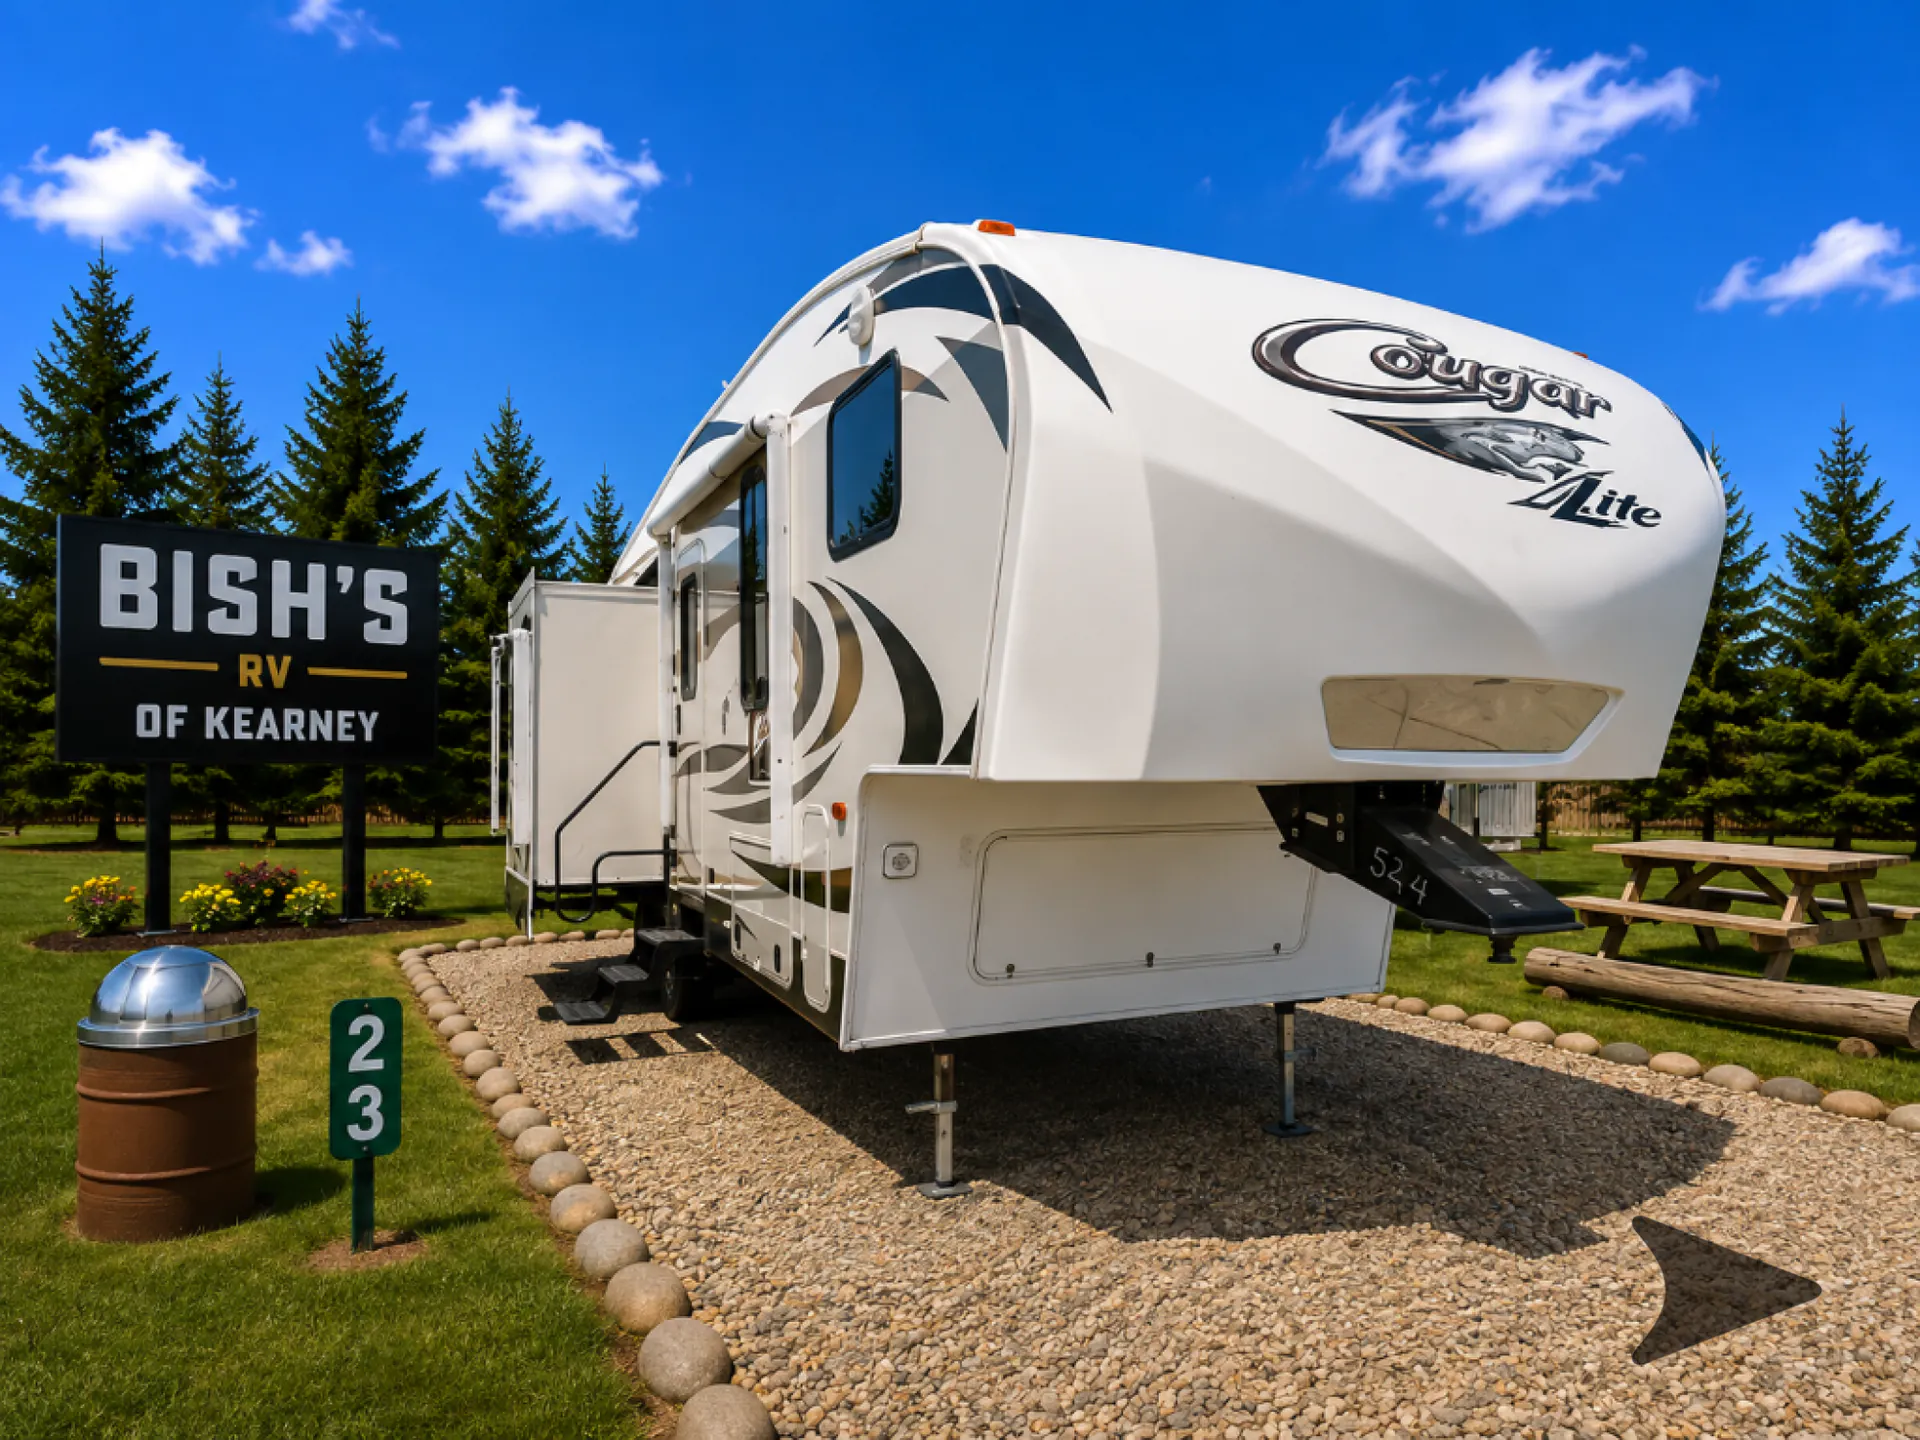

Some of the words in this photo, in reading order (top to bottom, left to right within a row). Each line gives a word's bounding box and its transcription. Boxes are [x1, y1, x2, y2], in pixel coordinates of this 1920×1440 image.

[1252, 318, 1612, 420] Cougar
[100, 543, 408, 646] BISH'S
[239, 653, 292, 689] RV
[136, 703, 189, 739] OF
[204, 705, 379, 742] KEARNEY
